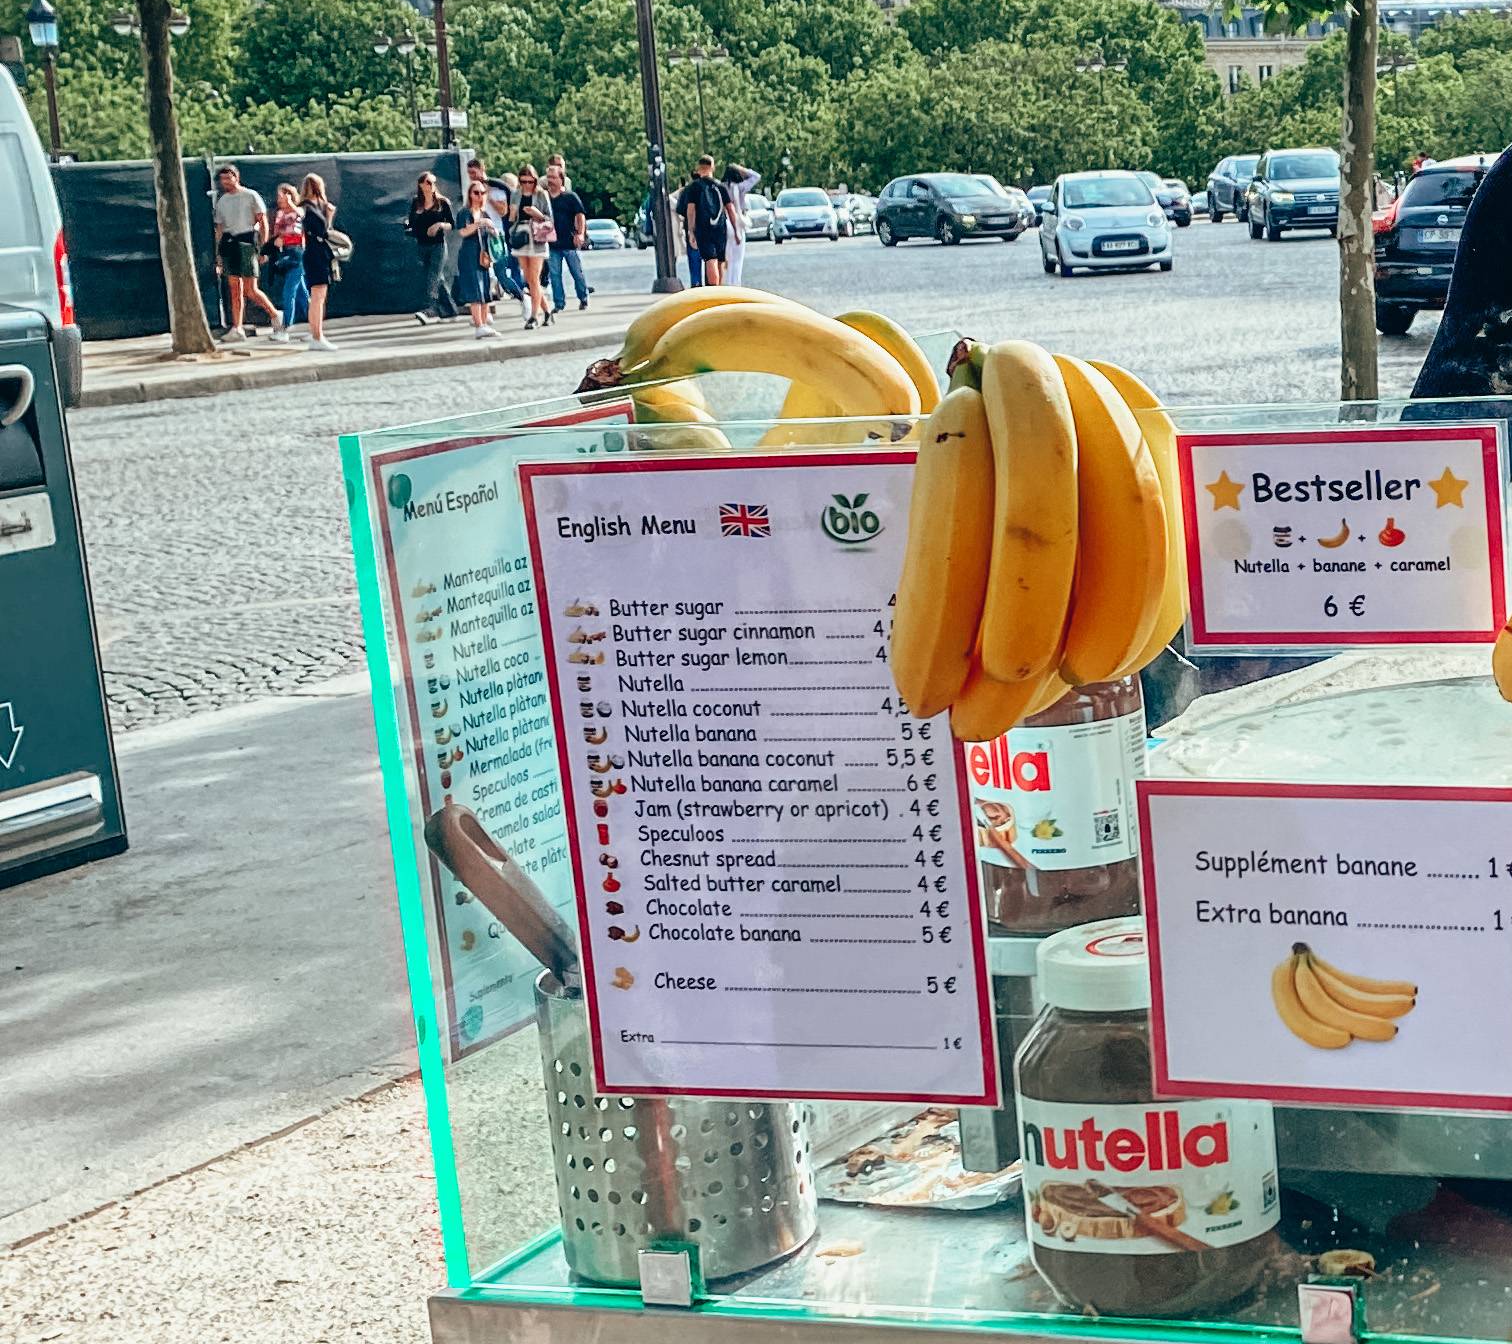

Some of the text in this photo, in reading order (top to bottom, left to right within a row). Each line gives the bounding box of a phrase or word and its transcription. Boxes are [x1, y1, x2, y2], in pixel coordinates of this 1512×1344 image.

[1251, 469, 1421, 503] Bestseller
[403, 481, 498, 522] Menú Español
[556, 514, 697, 544] English Menu
[828, 508, 882, 537] bio
[444, 555, 512, 590] Mantequilla
[1233, 555, 1451, 574] Nutella banane caramel
[447, 579, 515, 614] Mantequilla
[1323, 594, 1366, 618] 6 €
[450, 603, 518, 638] Mantequilla
[609, 598, 724, 621] Butter sugar
[612, 622, 816, 647] Butter sugar cinnamon
[452, 635, 498, 662] Nutella
[615, 646, 789, 672] Butter sugar lemon
[456, 651, 530, 685] Nutella coco
[460, 681, 504, 708] Nutella
[617, 673, 685, 693] Nutella
[463, 704, 508, 729] Nutella
[620, 698, 762, 718] Nutella coconut
[466, 728, 510, 755] Nutella
[624, 723, 758, 743] Nutella banana
[470, 747, 533, 778] Mermalada
[627, 748, 836, 768] Nutella banana coconut
[472, 769, 529, 803] Speculoos
[630, 773, 839, 793] Nutella banana caramel
[514, 790, 530, 807] de
[633, 798, 889, 823] Jam (strawberry or apricot)
[637, 823, 725, 848] Speculoos
[639, 848, 777, 873] Chesnut spread
[1194, 849, 1328, 879] Supplément
[1336, 852, 1419, 877] banane
[1487, 856, 1499, 879] 1
[643, 873, 842, 894] Salted butter caramel
[645, 897, 733, 917] Chocolate
[1195, 899, 1262, 924] Extra
[1268, 902, 1349, 927] banana
[1493, 908, 1504, 931] 1
[648, 922, 802, 942] Chocolate banana
[653, 971, 718, 991] Cheese
[619, 1029, 656, 1044] Extra
[1024, 1110, 1230, 1172] nutella
